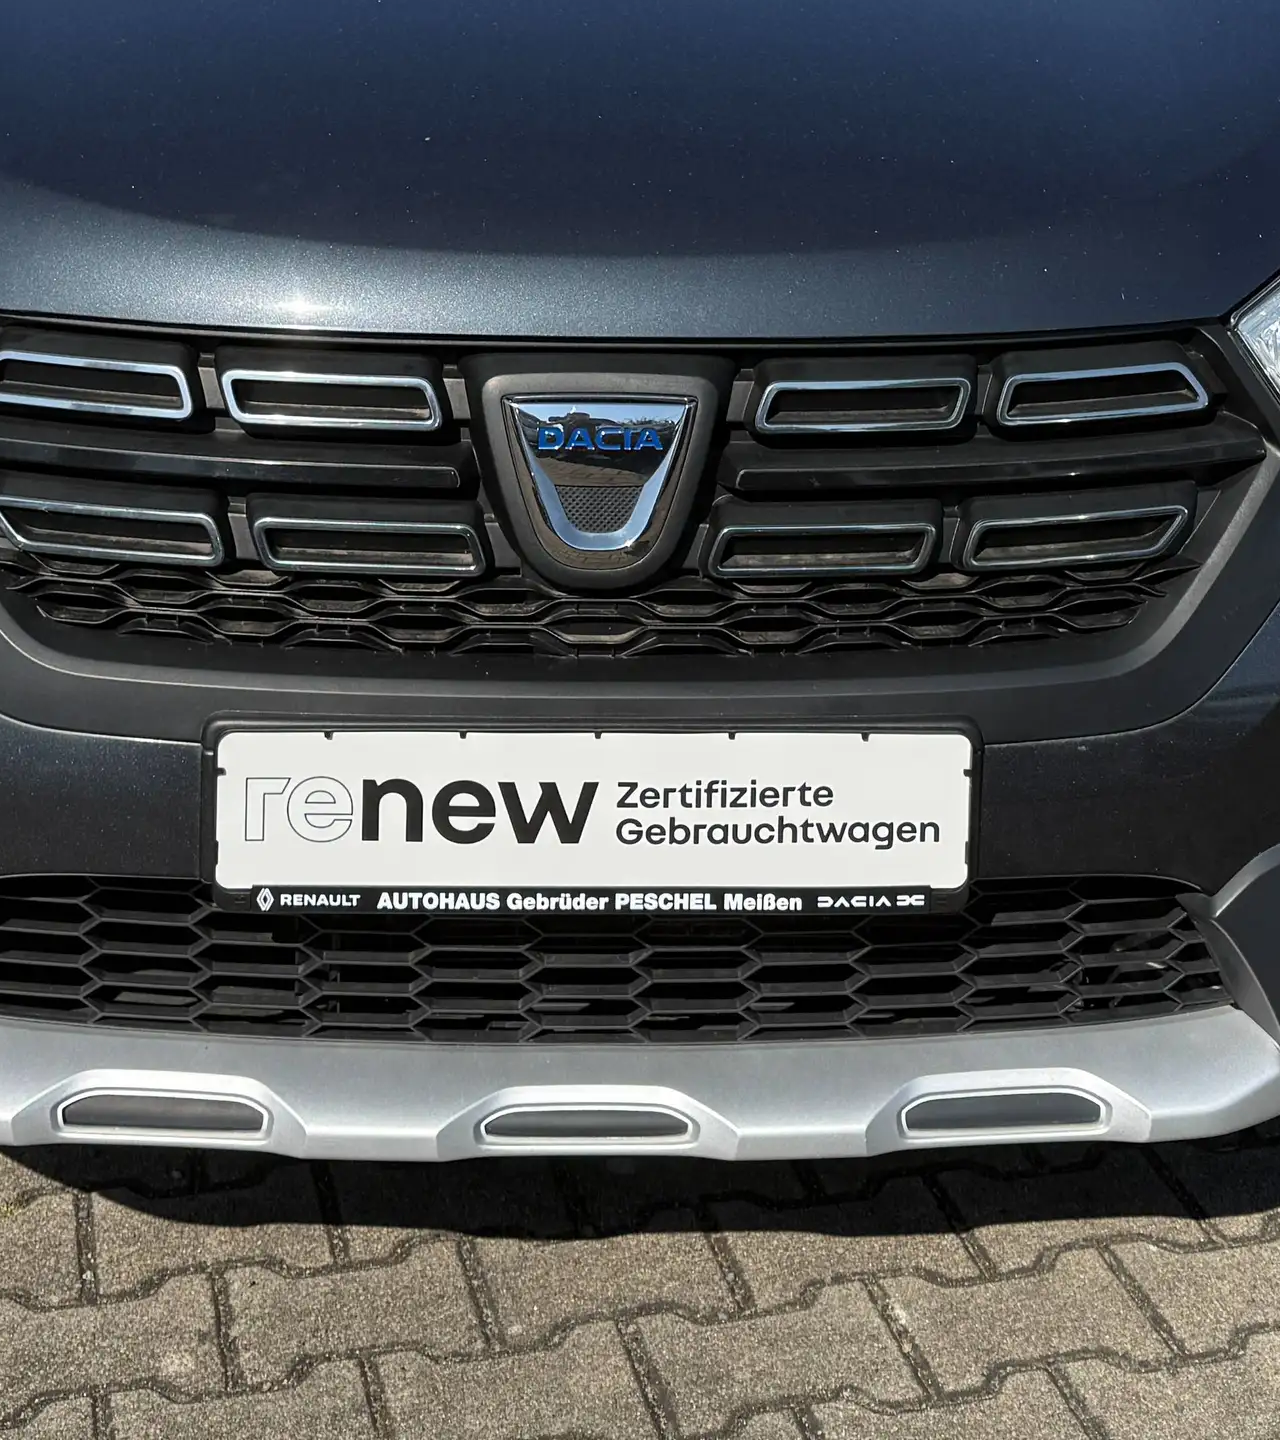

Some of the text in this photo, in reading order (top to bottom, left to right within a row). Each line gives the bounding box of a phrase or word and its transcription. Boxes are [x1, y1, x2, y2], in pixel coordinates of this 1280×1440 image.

[538, 427, 663, 450] DACIA
[616, 780, 834, 808] Zertifizierte
[245, 776, 600, 844] renew
[616, 816, 940, 850] Gebrauchtwagen
[280, 893, 361, 908] RENAULT
[376, 891, 501, 910] AUTOHAUS
[506, 891, 609, 911] Gebrüder
[614, 892, 717, 910] PESCHEL
[723, 892, 803, 911] Meißen
[817, 895, 892, 908] DACIA
